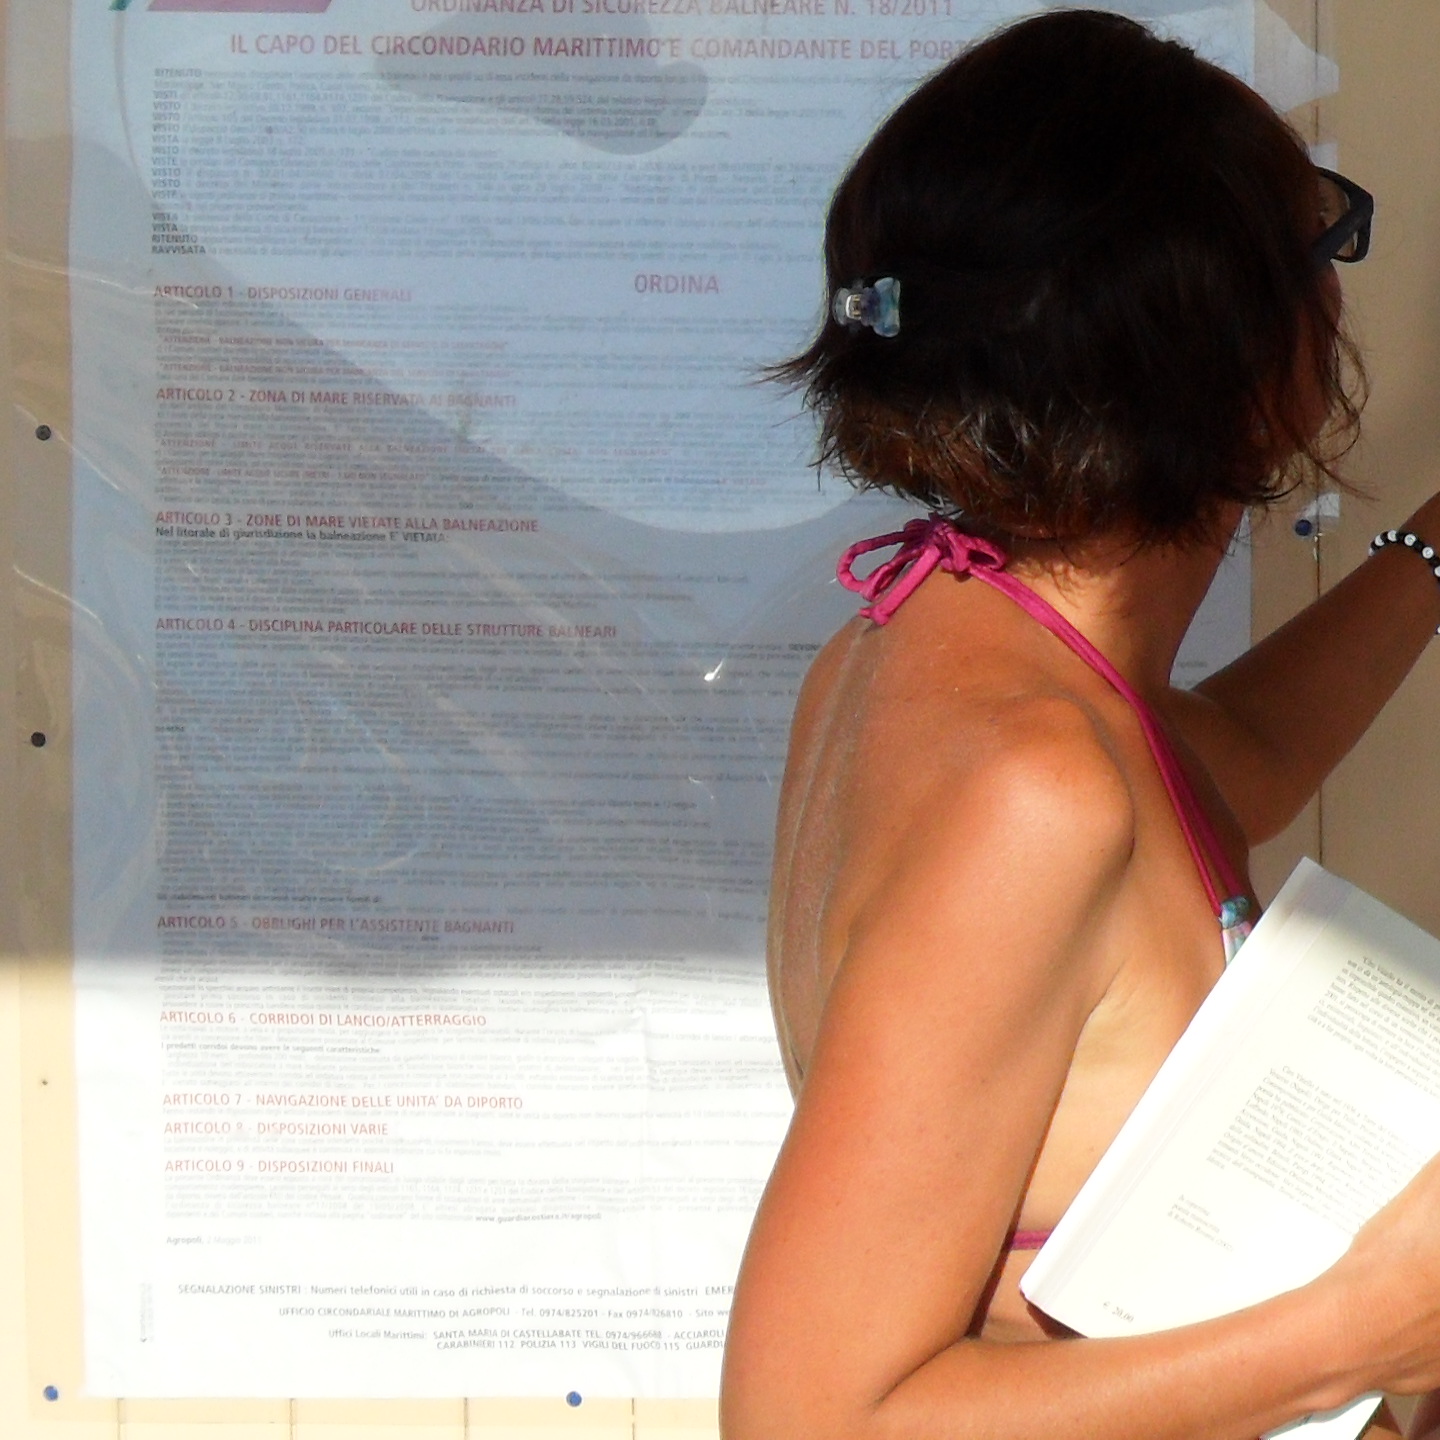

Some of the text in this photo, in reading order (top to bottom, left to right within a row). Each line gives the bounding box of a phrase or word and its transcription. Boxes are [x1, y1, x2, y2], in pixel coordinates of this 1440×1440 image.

[230, 35, 249, 55] IL
[254, 35, 316, 55] CAPO
[323, 35, 365, 56] DEL
[370, 35, 526, 58] CIRCONDARIO
[691, 38, 853, 61] COMANDANTE
[860, 39, 905, 61] DEL
[634, 273, 720, 296] ORDINA
[165, 1160, 394, 1173] ARTICOLO 9 DISPOSIZIONI FINALI
